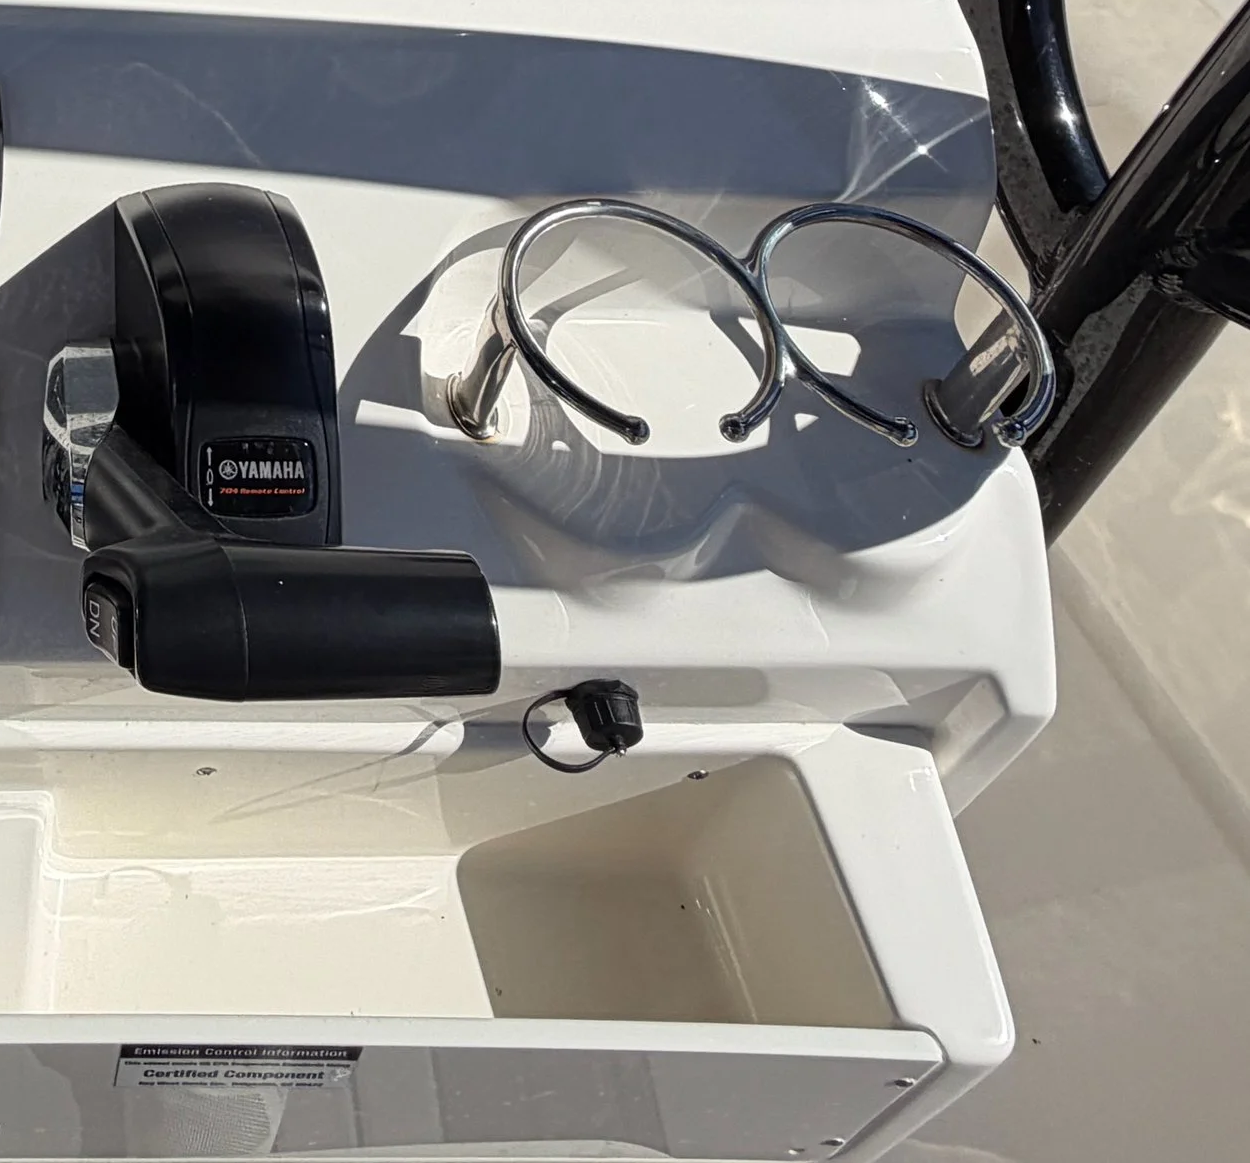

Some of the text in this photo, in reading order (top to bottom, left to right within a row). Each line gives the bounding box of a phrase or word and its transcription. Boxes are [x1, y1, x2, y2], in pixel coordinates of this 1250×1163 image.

[239, 461, 305, 480] YAMAHA
[89, 599, 101, 638] DN
[134, 1047, 348, 1057] Emission Control Information
[143, 1068, 325, 1080] Certified Component
